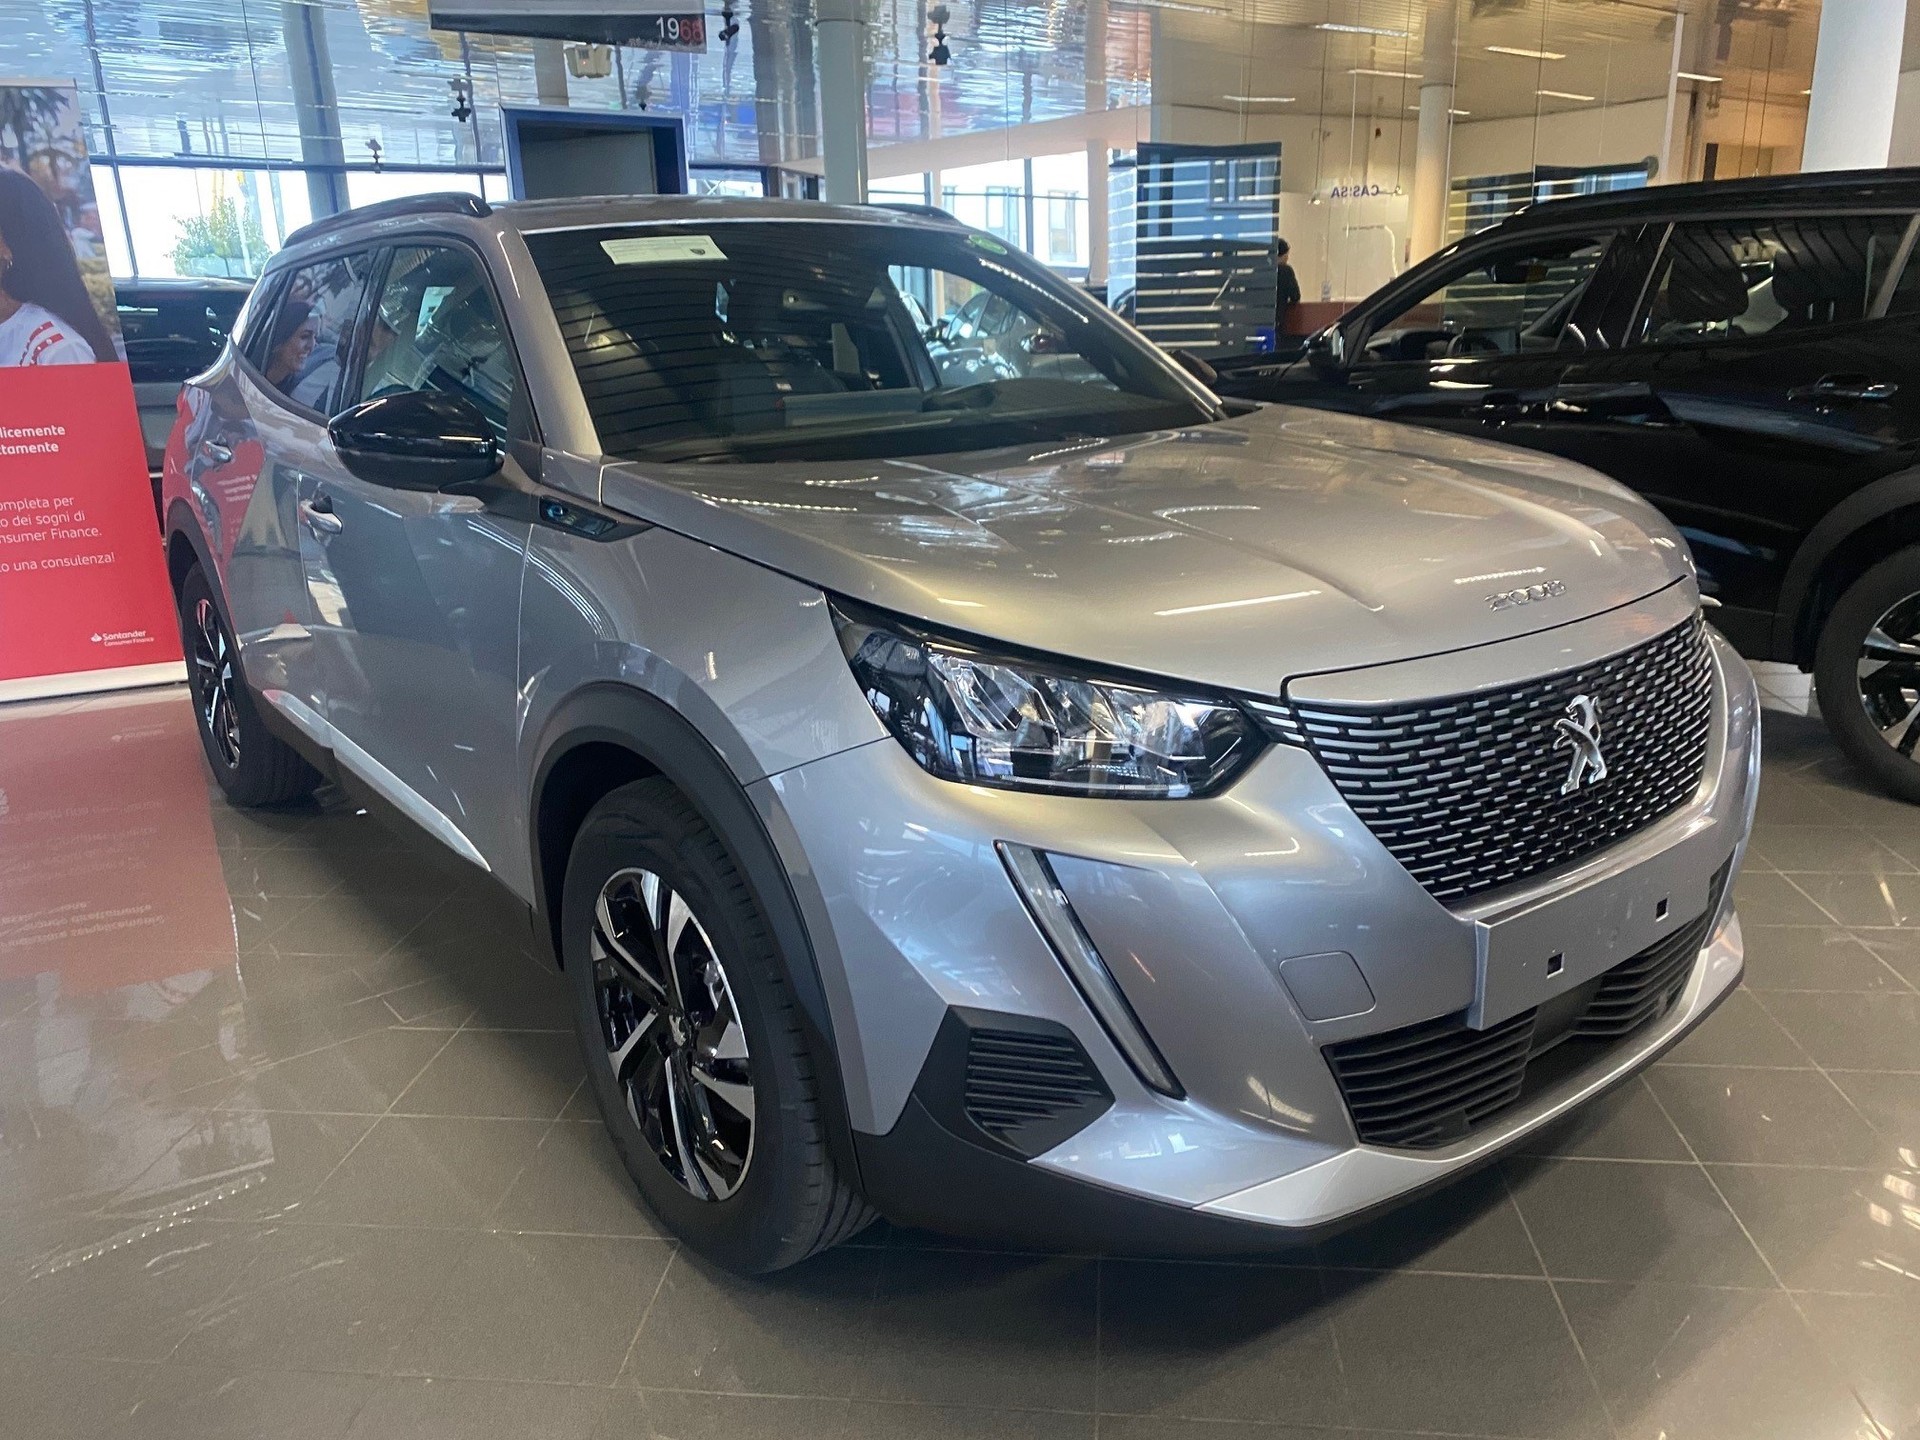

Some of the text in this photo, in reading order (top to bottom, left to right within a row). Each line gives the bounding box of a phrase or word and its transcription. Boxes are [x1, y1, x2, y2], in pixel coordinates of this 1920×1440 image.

[0, 442, 60, 455] tamente
[54, 497, 74, 510] per
[12, 514, 32, 526] dei
[36, 512, 70, 526] sogni
[74, 510, 86, 522] di
[50, 527, 102, 540] Finance.
[13, 560, 38, 571] una
[41, 552, 116, 569] consulenza!
[1484, 580, 1567, 613] 2008
[102, 630, 146, 641] Santander
